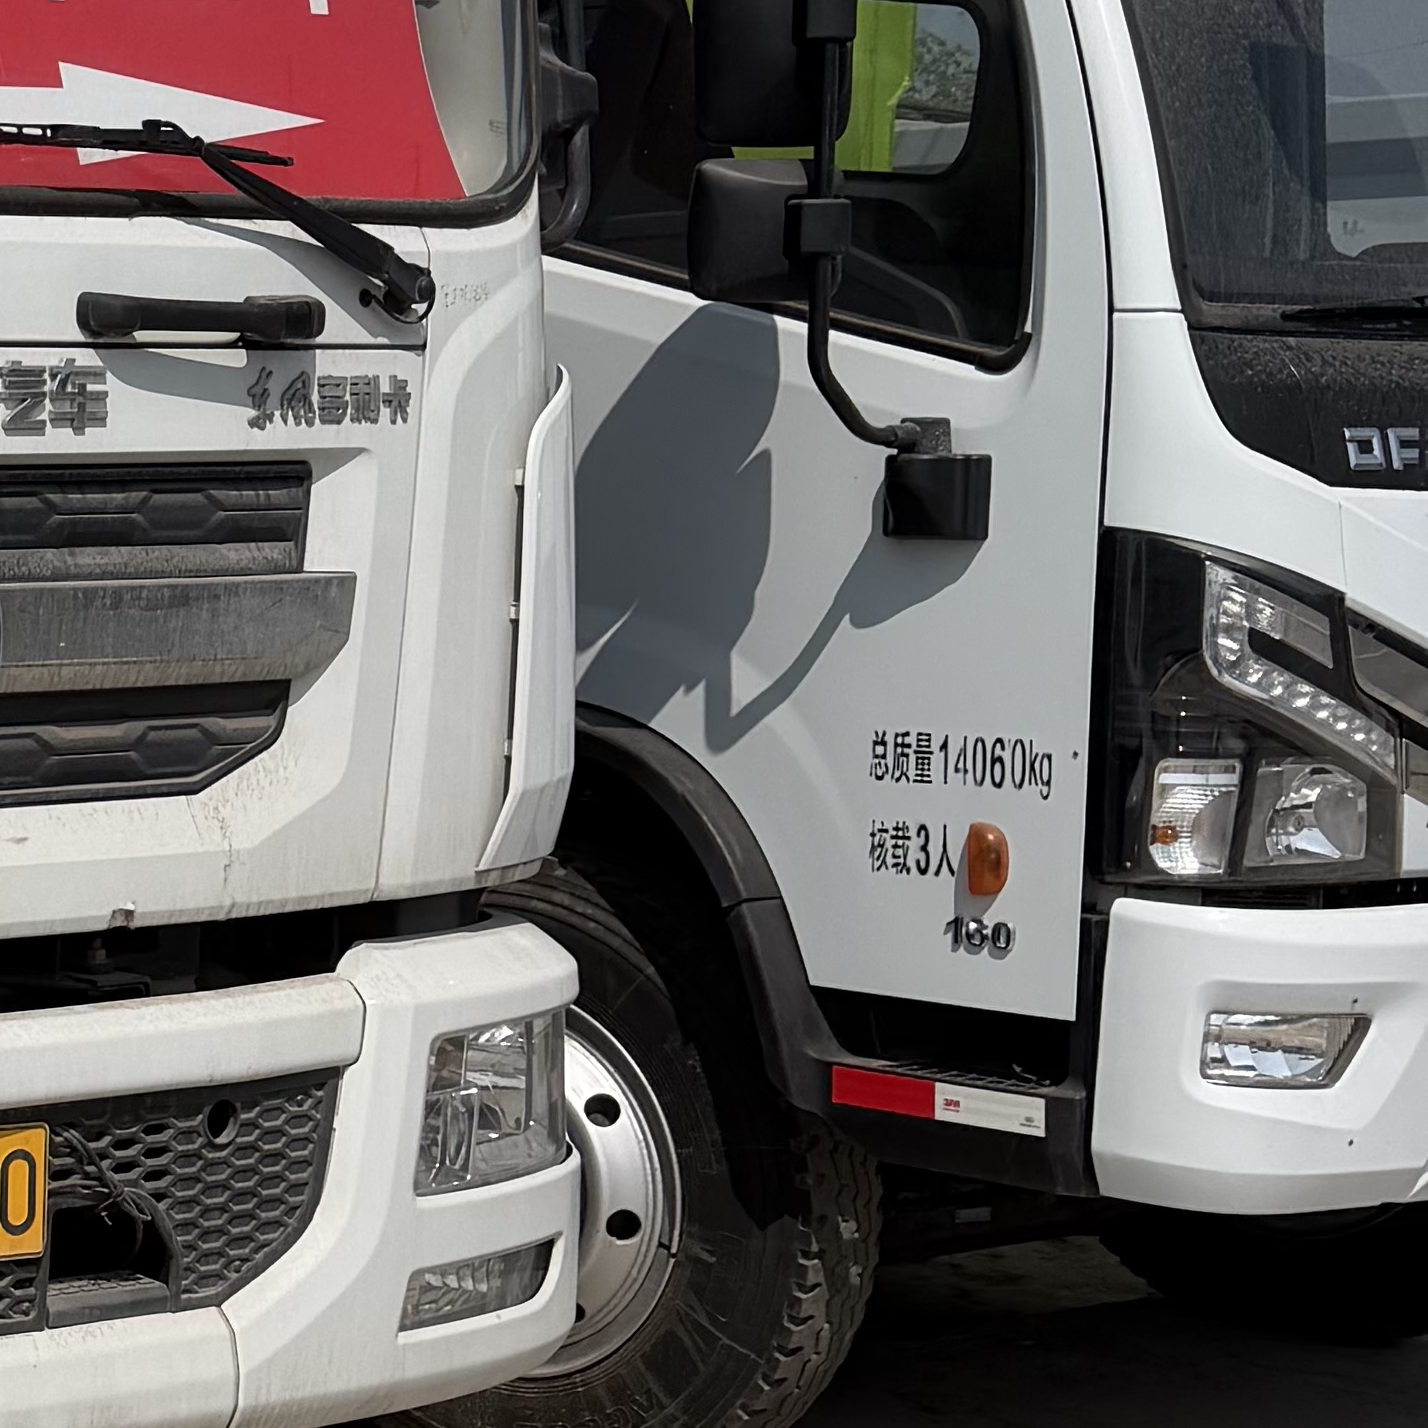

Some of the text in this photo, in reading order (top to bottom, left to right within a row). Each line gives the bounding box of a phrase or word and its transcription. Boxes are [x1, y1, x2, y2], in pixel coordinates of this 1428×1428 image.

[1343, 427, 1428, 471] DF
[869, 819, 955, 878] 核载3人
